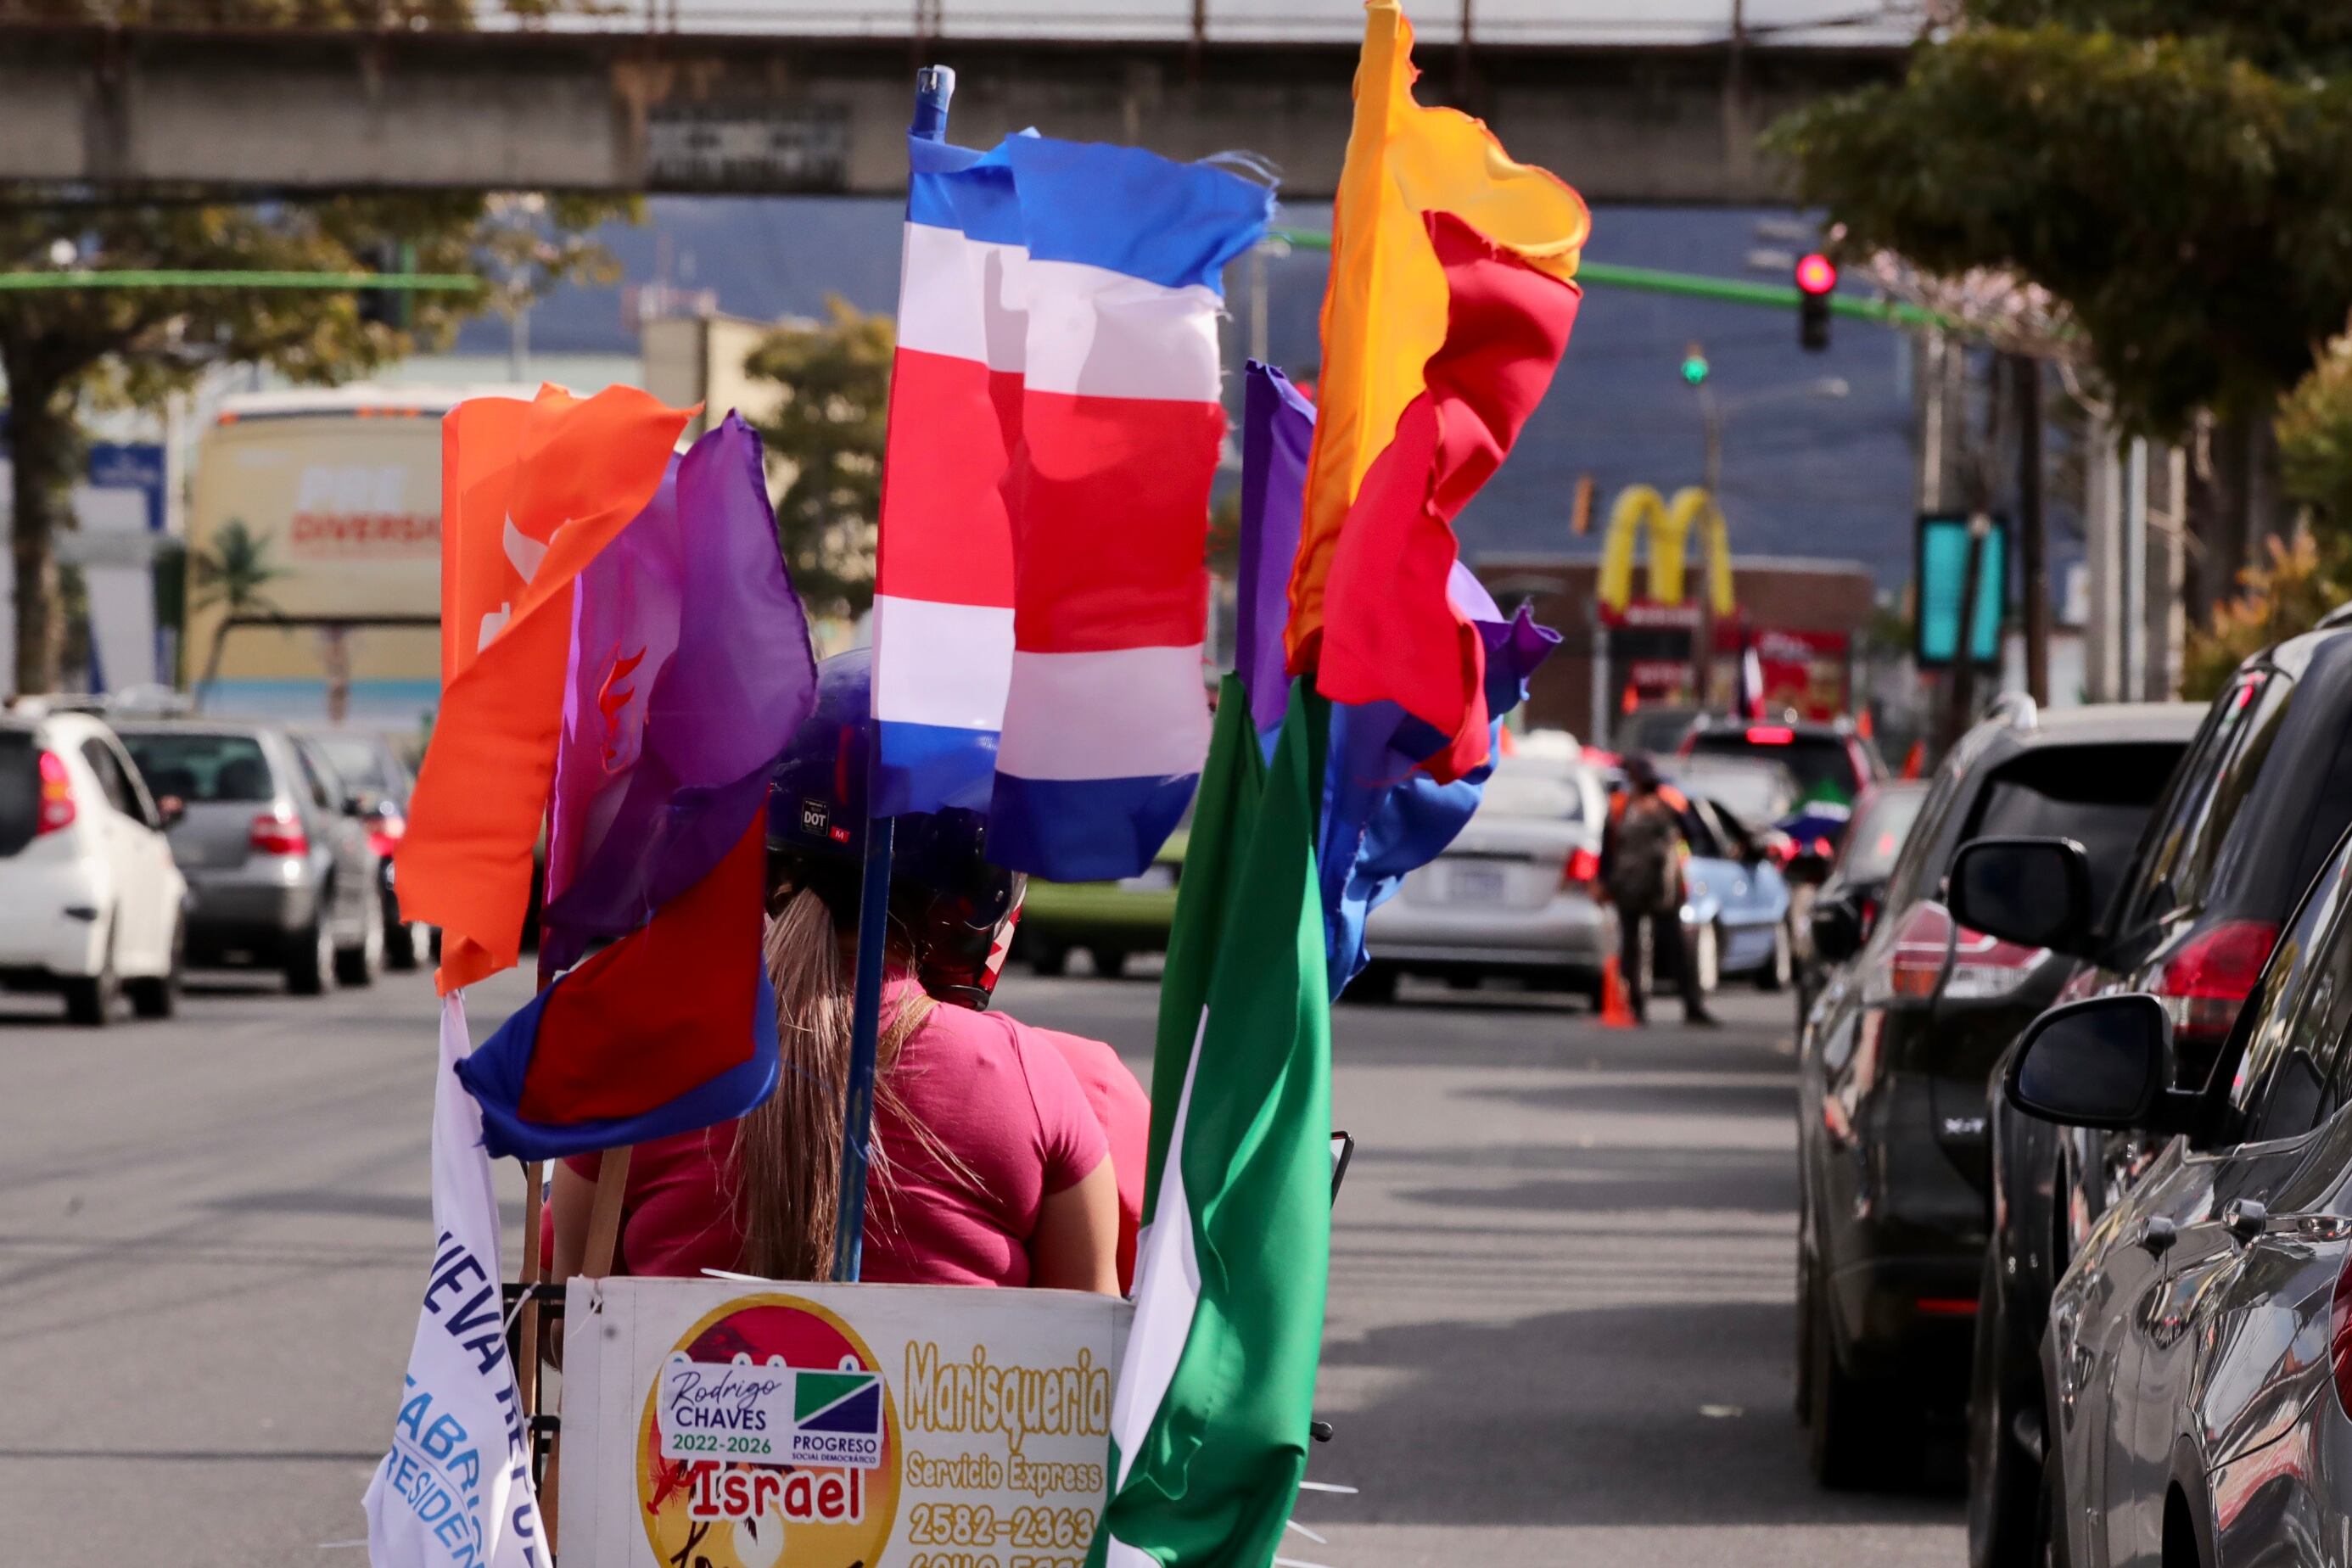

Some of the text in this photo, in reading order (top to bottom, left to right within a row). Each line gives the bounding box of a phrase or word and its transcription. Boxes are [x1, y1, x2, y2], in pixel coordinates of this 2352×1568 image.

[804, 810, 826, 827] DOT
[835, 830, 844, 840] M
[670, 1369, 782, 1411] Rodrigo
[904, 1341, 1111, 1453] Marisqueria
[675, 1406, 767, 1431] CHAVES
[672, 1434, 772, 1454] 2022-2026
[792, 1436, 877, 1454] PROGRESO
[792, 1452, 877, 1464] SOCIAL DEMOCRÁTICO
[906, 1450, 1103, 1498] Servicio Express
[692, 1459, 860, 1519] Israel
[909, 1503, 1095, 1551] 2582-2363
